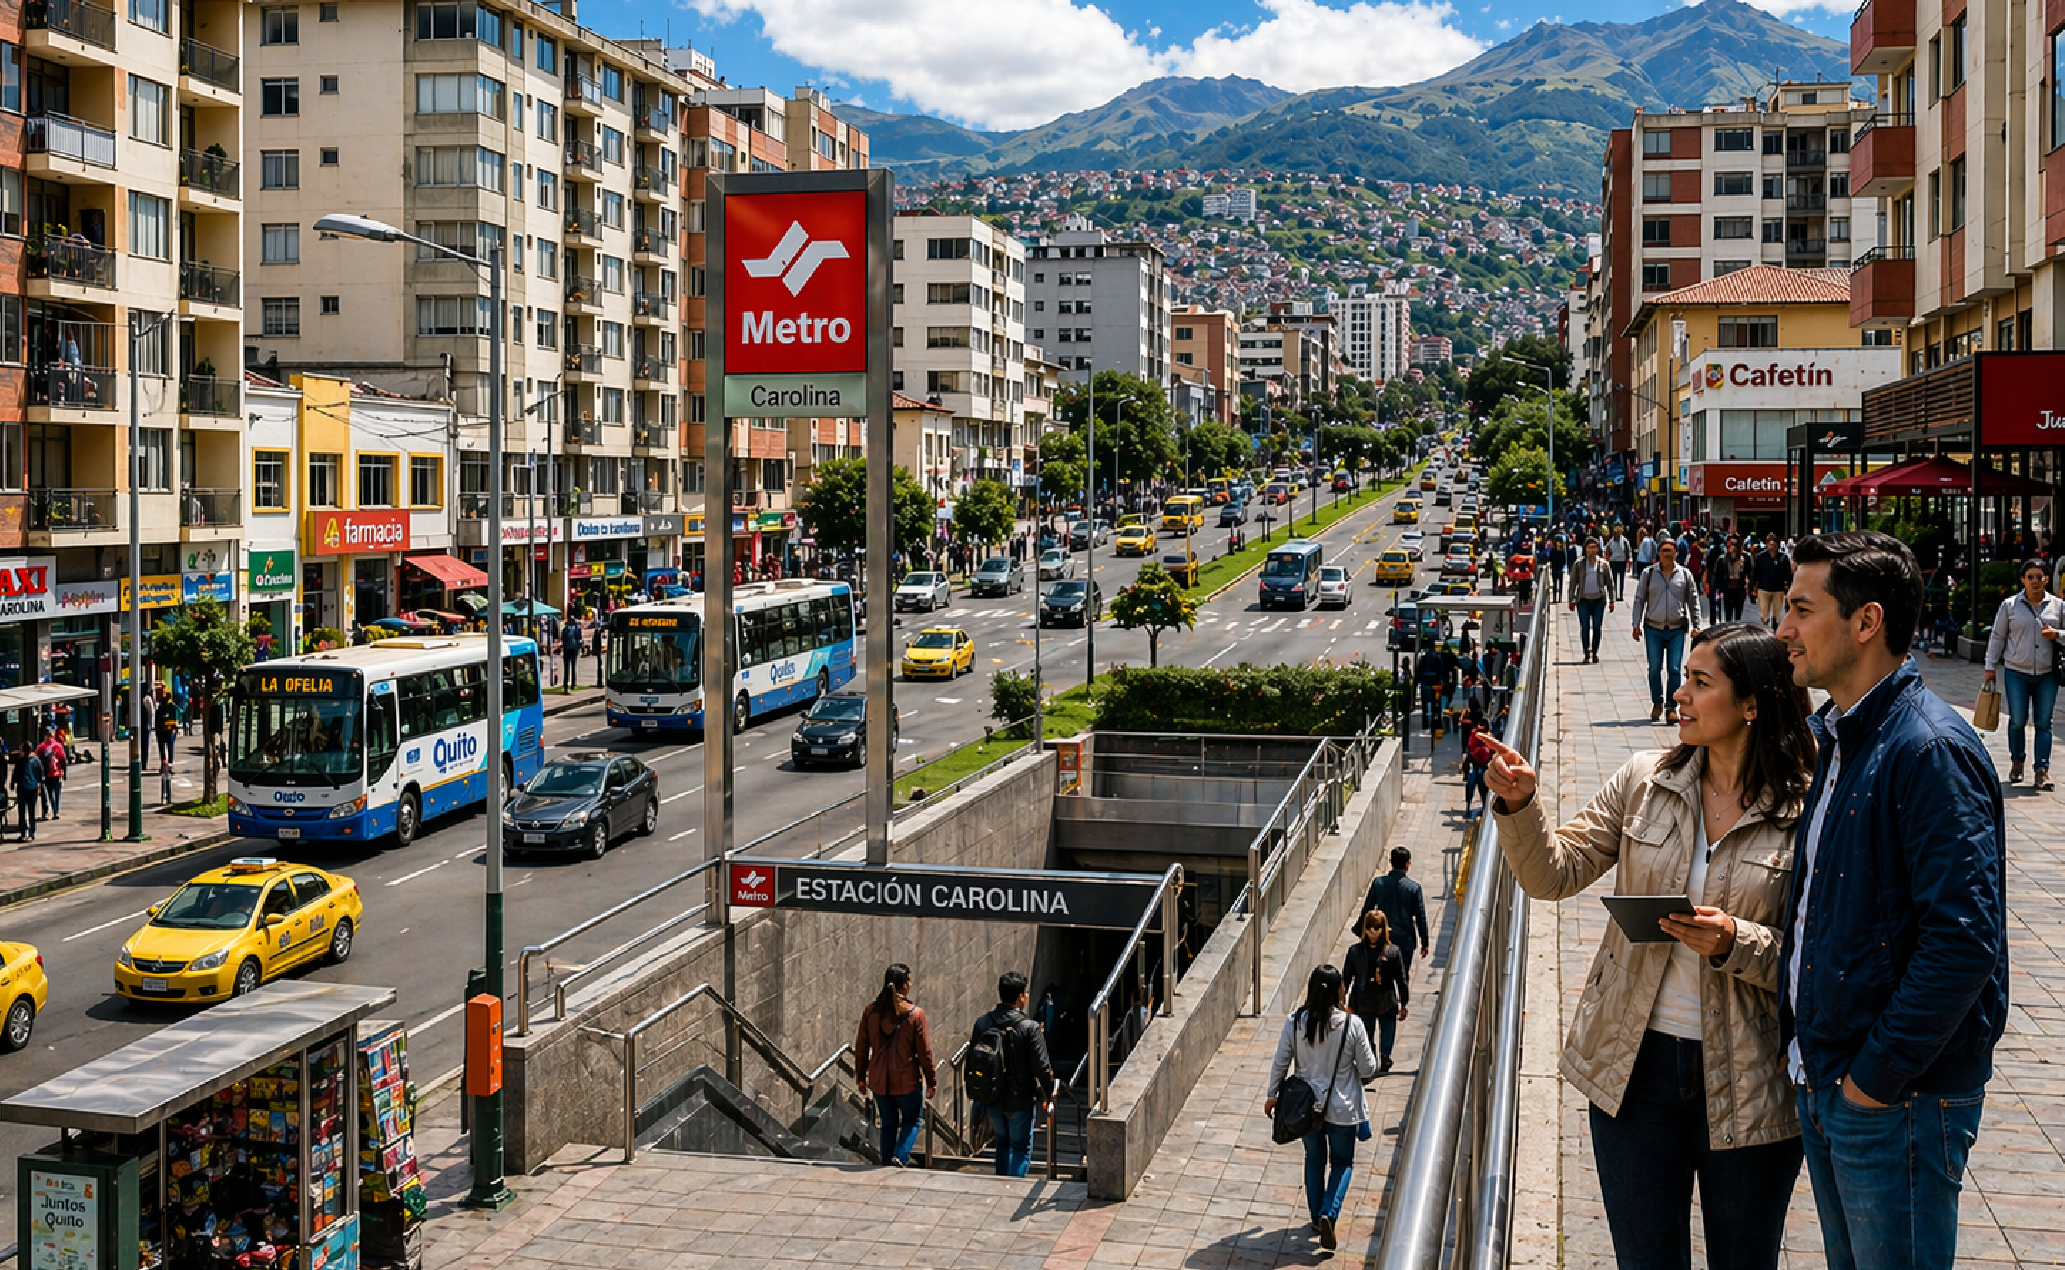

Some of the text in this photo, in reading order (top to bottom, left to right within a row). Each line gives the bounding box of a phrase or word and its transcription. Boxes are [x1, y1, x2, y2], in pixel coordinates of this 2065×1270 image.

[741, 310, 852, 344] Metro
[1730, 361, 1834, 388] Cafetín
[750, 384, 841, 408] Carolina
[1725, 477, 1782, 491] Cafetin
[343, 517, 404, 544] farmacia
[262, 677, 334, 693] LA OFELIA
[433, 731, 478, 774] Quito
[795, 875, 1071, 915] ESTACIÓN CAROLINA
[41, 1195, 86, 1213] Juntos
